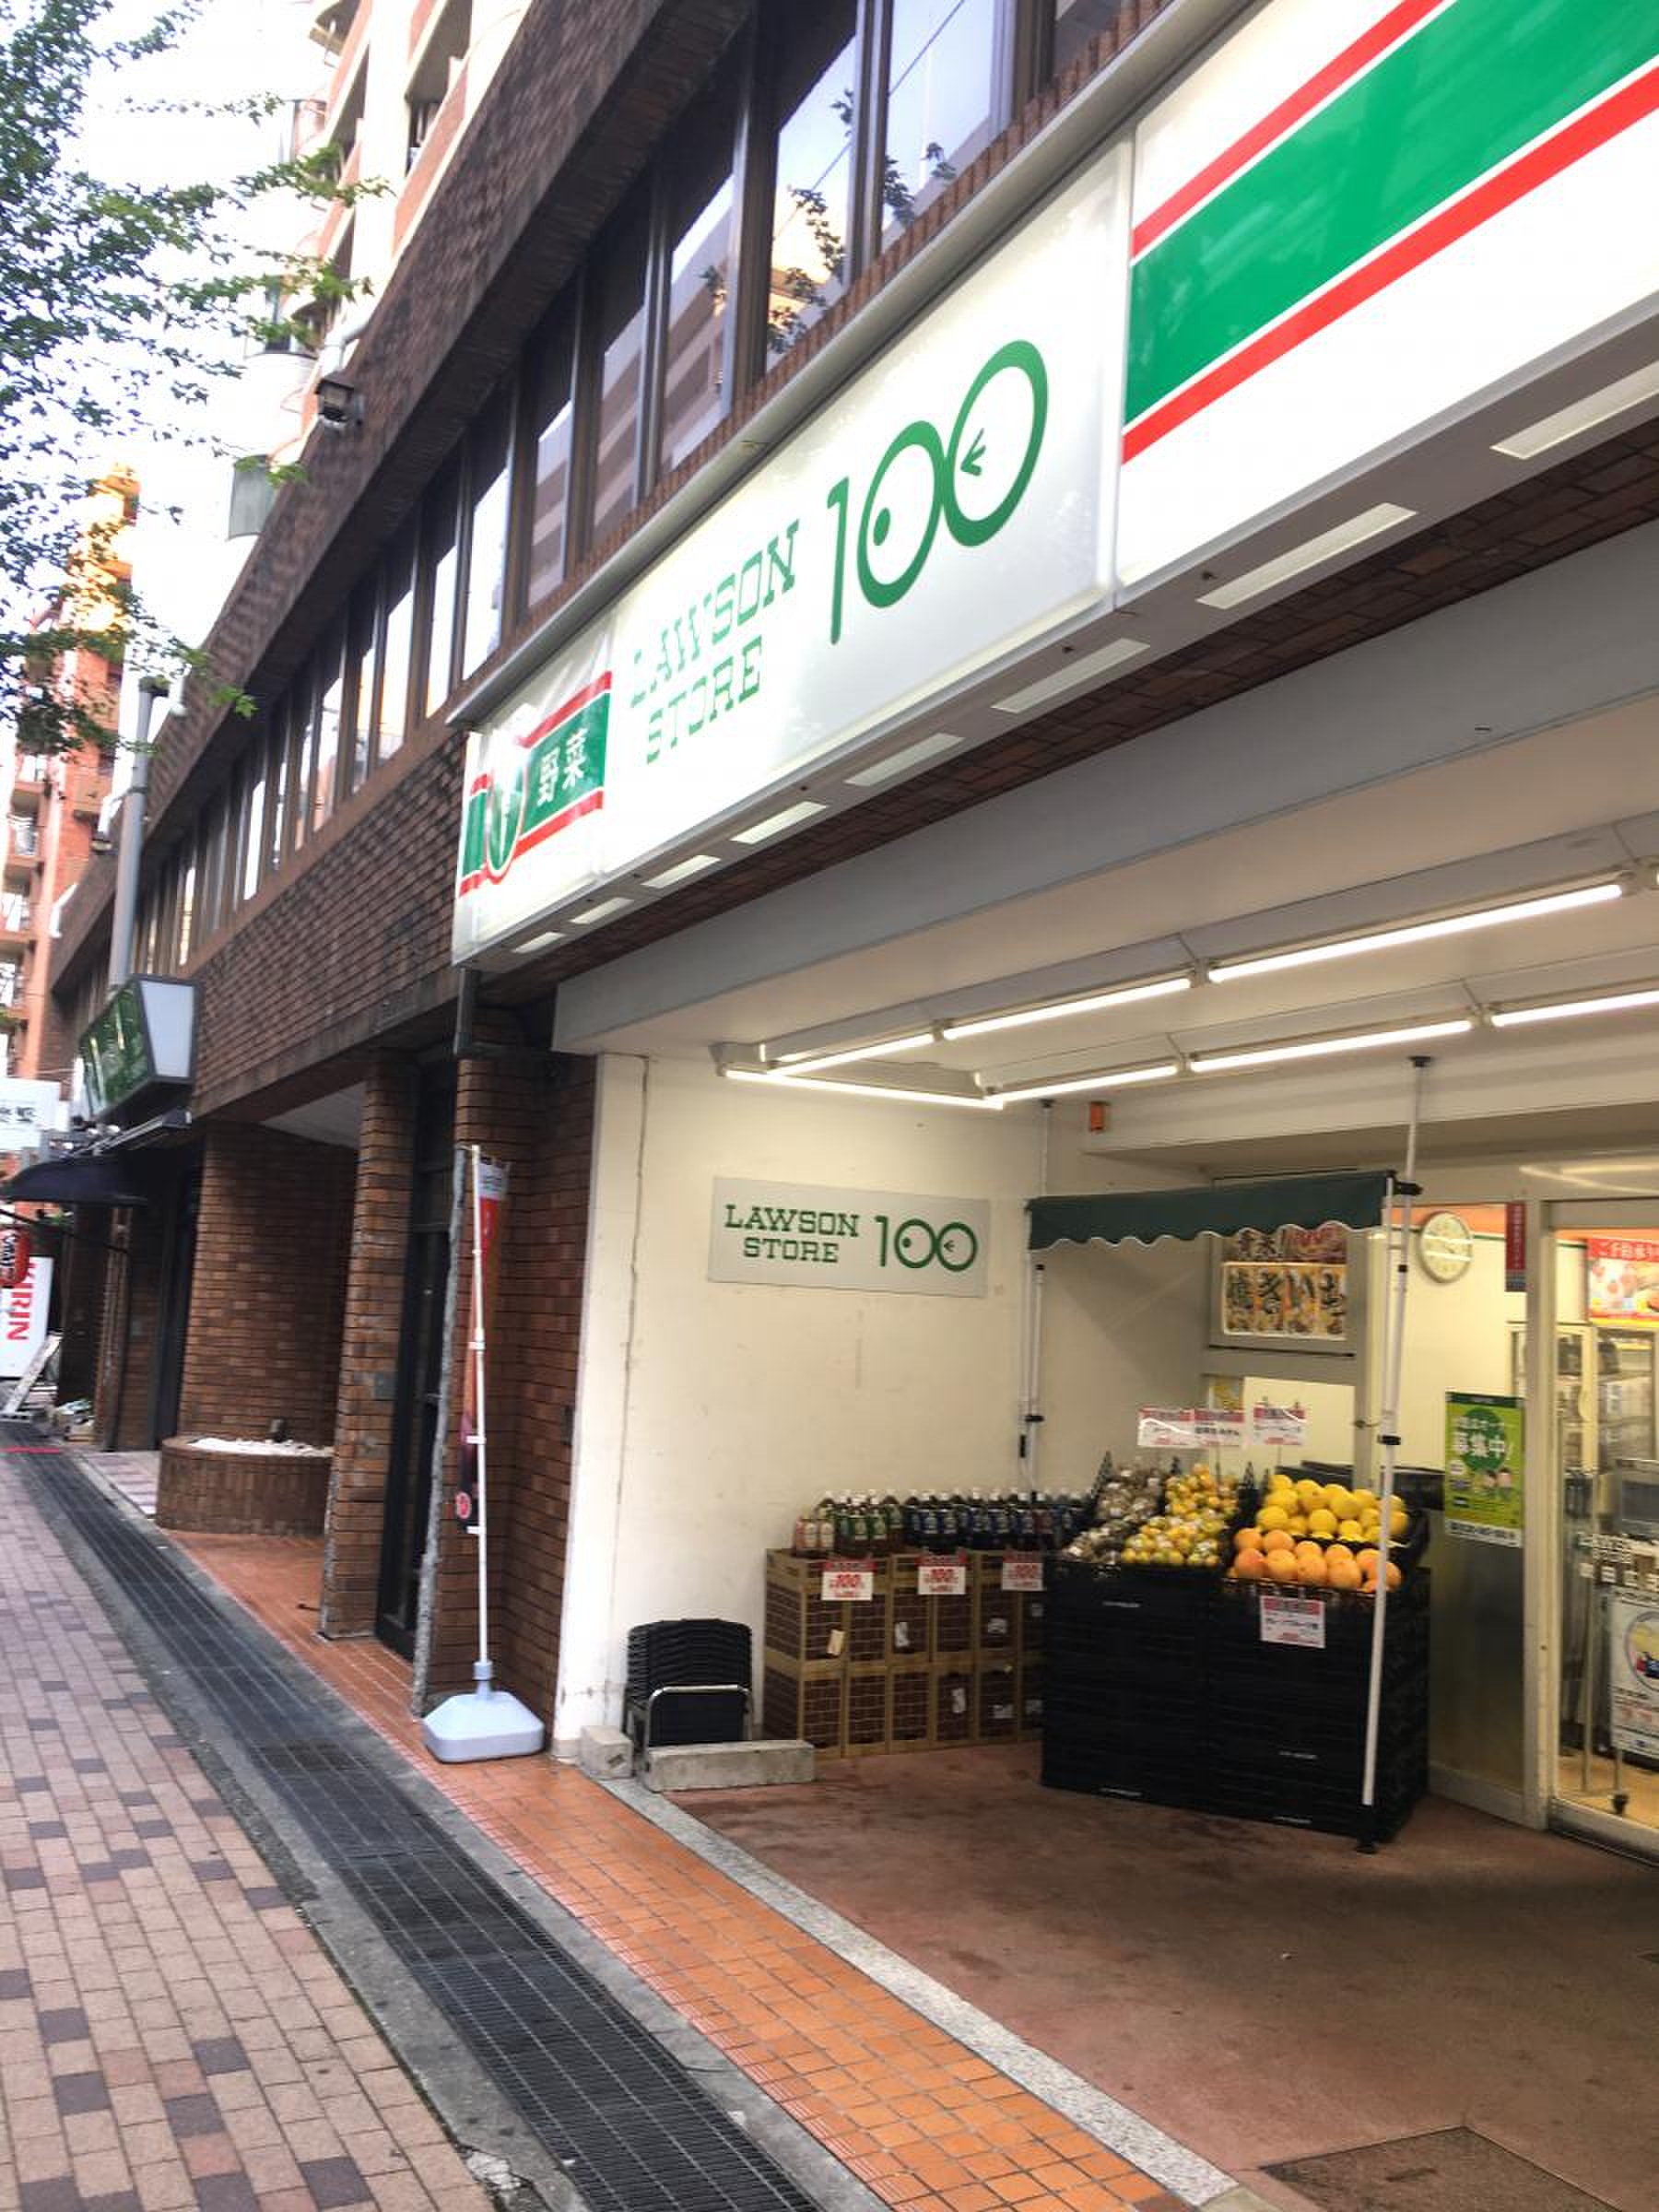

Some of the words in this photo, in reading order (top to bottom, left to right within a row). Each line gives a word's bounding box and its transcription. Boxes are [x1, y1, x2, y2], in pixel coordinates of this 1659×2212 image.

[826, 339, 1049, 645] 100
[630, 518, 799, 708] LAWSON
[647, 634, 762, 765] STORE
[535, 726, 589, 807] 野菜
[724, 1204, 860, 1238] LAWSON
[874, 1214, 978, 1272] 100
[743, 1236, 840, 1264] STORE
